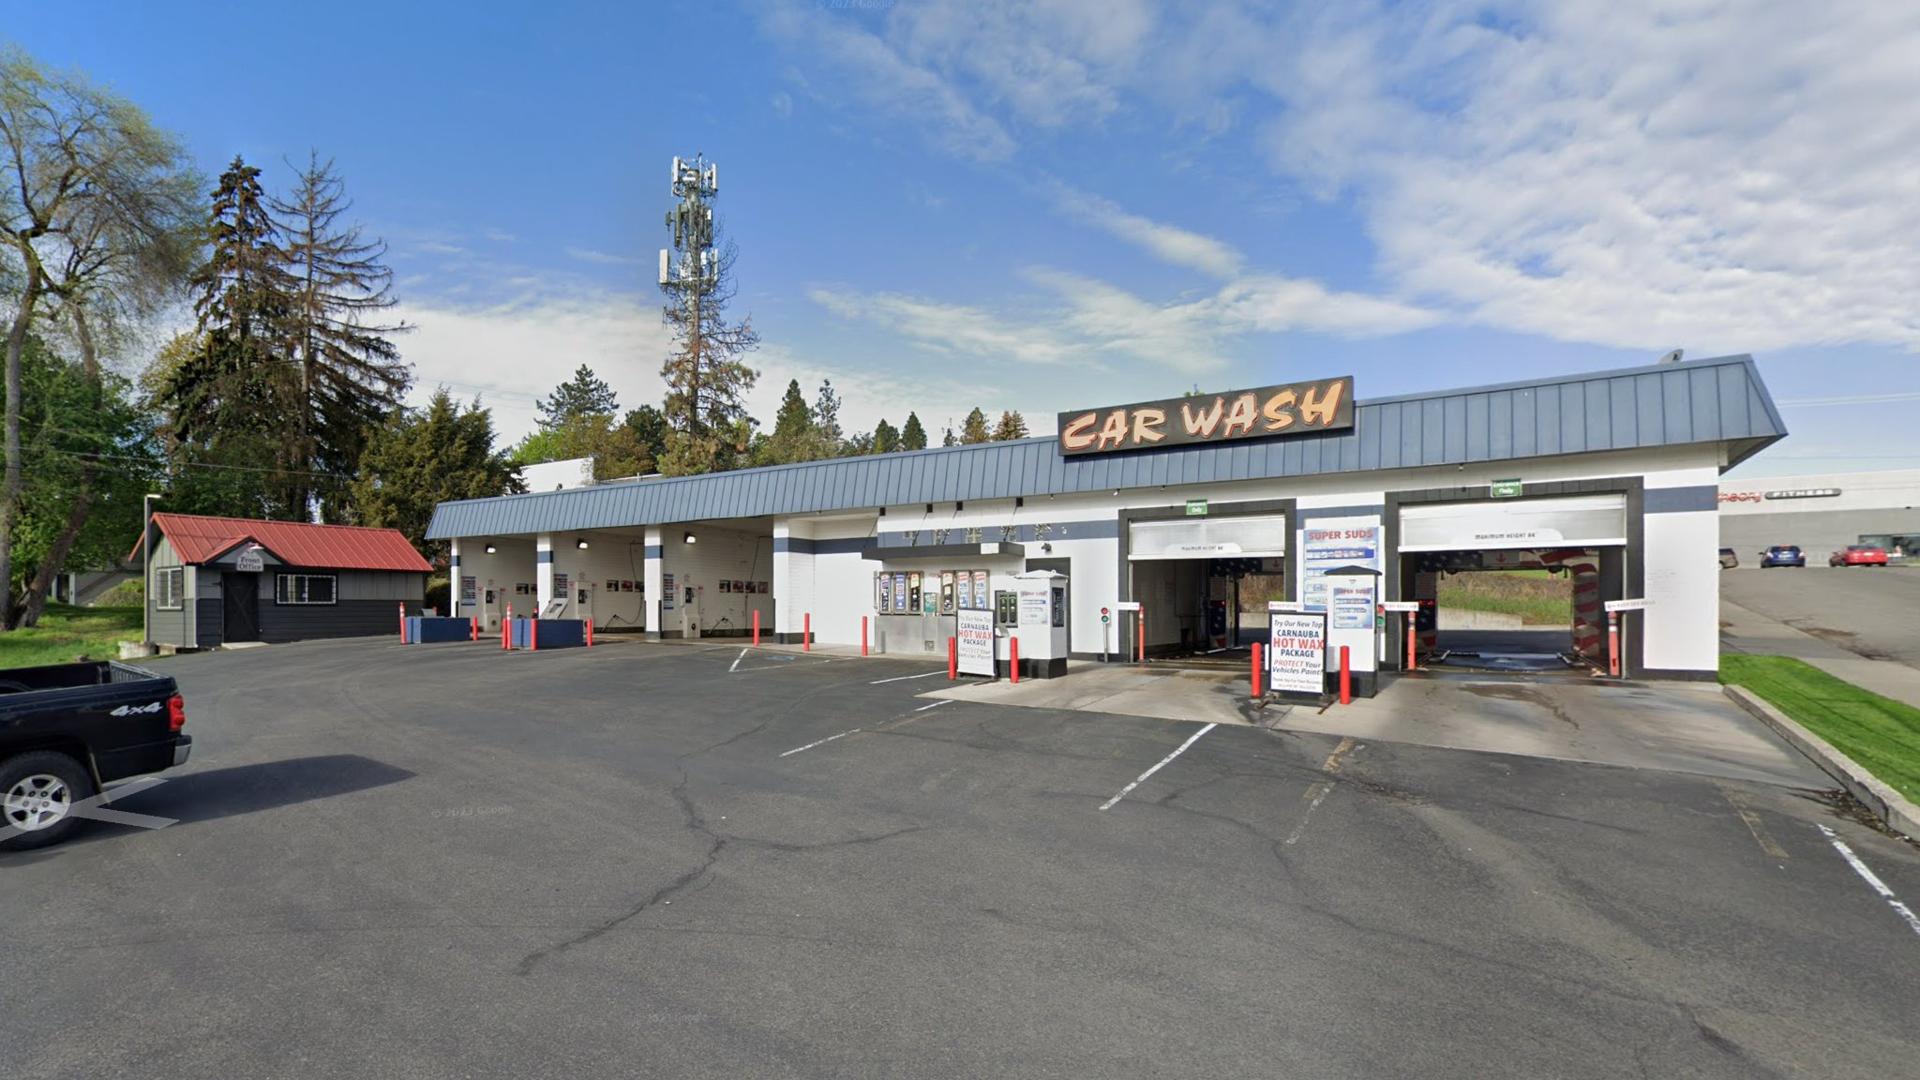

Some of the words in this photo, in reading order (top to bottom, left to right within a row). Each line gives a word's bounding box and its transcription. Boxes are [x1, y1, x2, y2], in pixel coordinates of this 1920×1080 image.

[1062, 408, 1168, 451] CAR
[1180, 379, 1346, 439] WASH
[1308, 530, 1341, 540] SUPER
[1345, 529, 1374, 539] SUDS
[961, 623, 989, 631] CARNAUBA
[1311, 621, 1323, 629] Top
[958, 629, 974, 638] HOT
[975, 631, 993, 640] WAX
[1277, 629, 1319, 638] CARNAUBA
[1273, 638, 1295, 649] HOT
[1298, 639, 1325, 650] WAX
[1280, 649, 1315, 658] PACKAGE
[1274, 659, 1304, 668] PROTECT
[1272, 666, 1300, 674] Vehicles
[110, 702, 163, 716] 4x4
